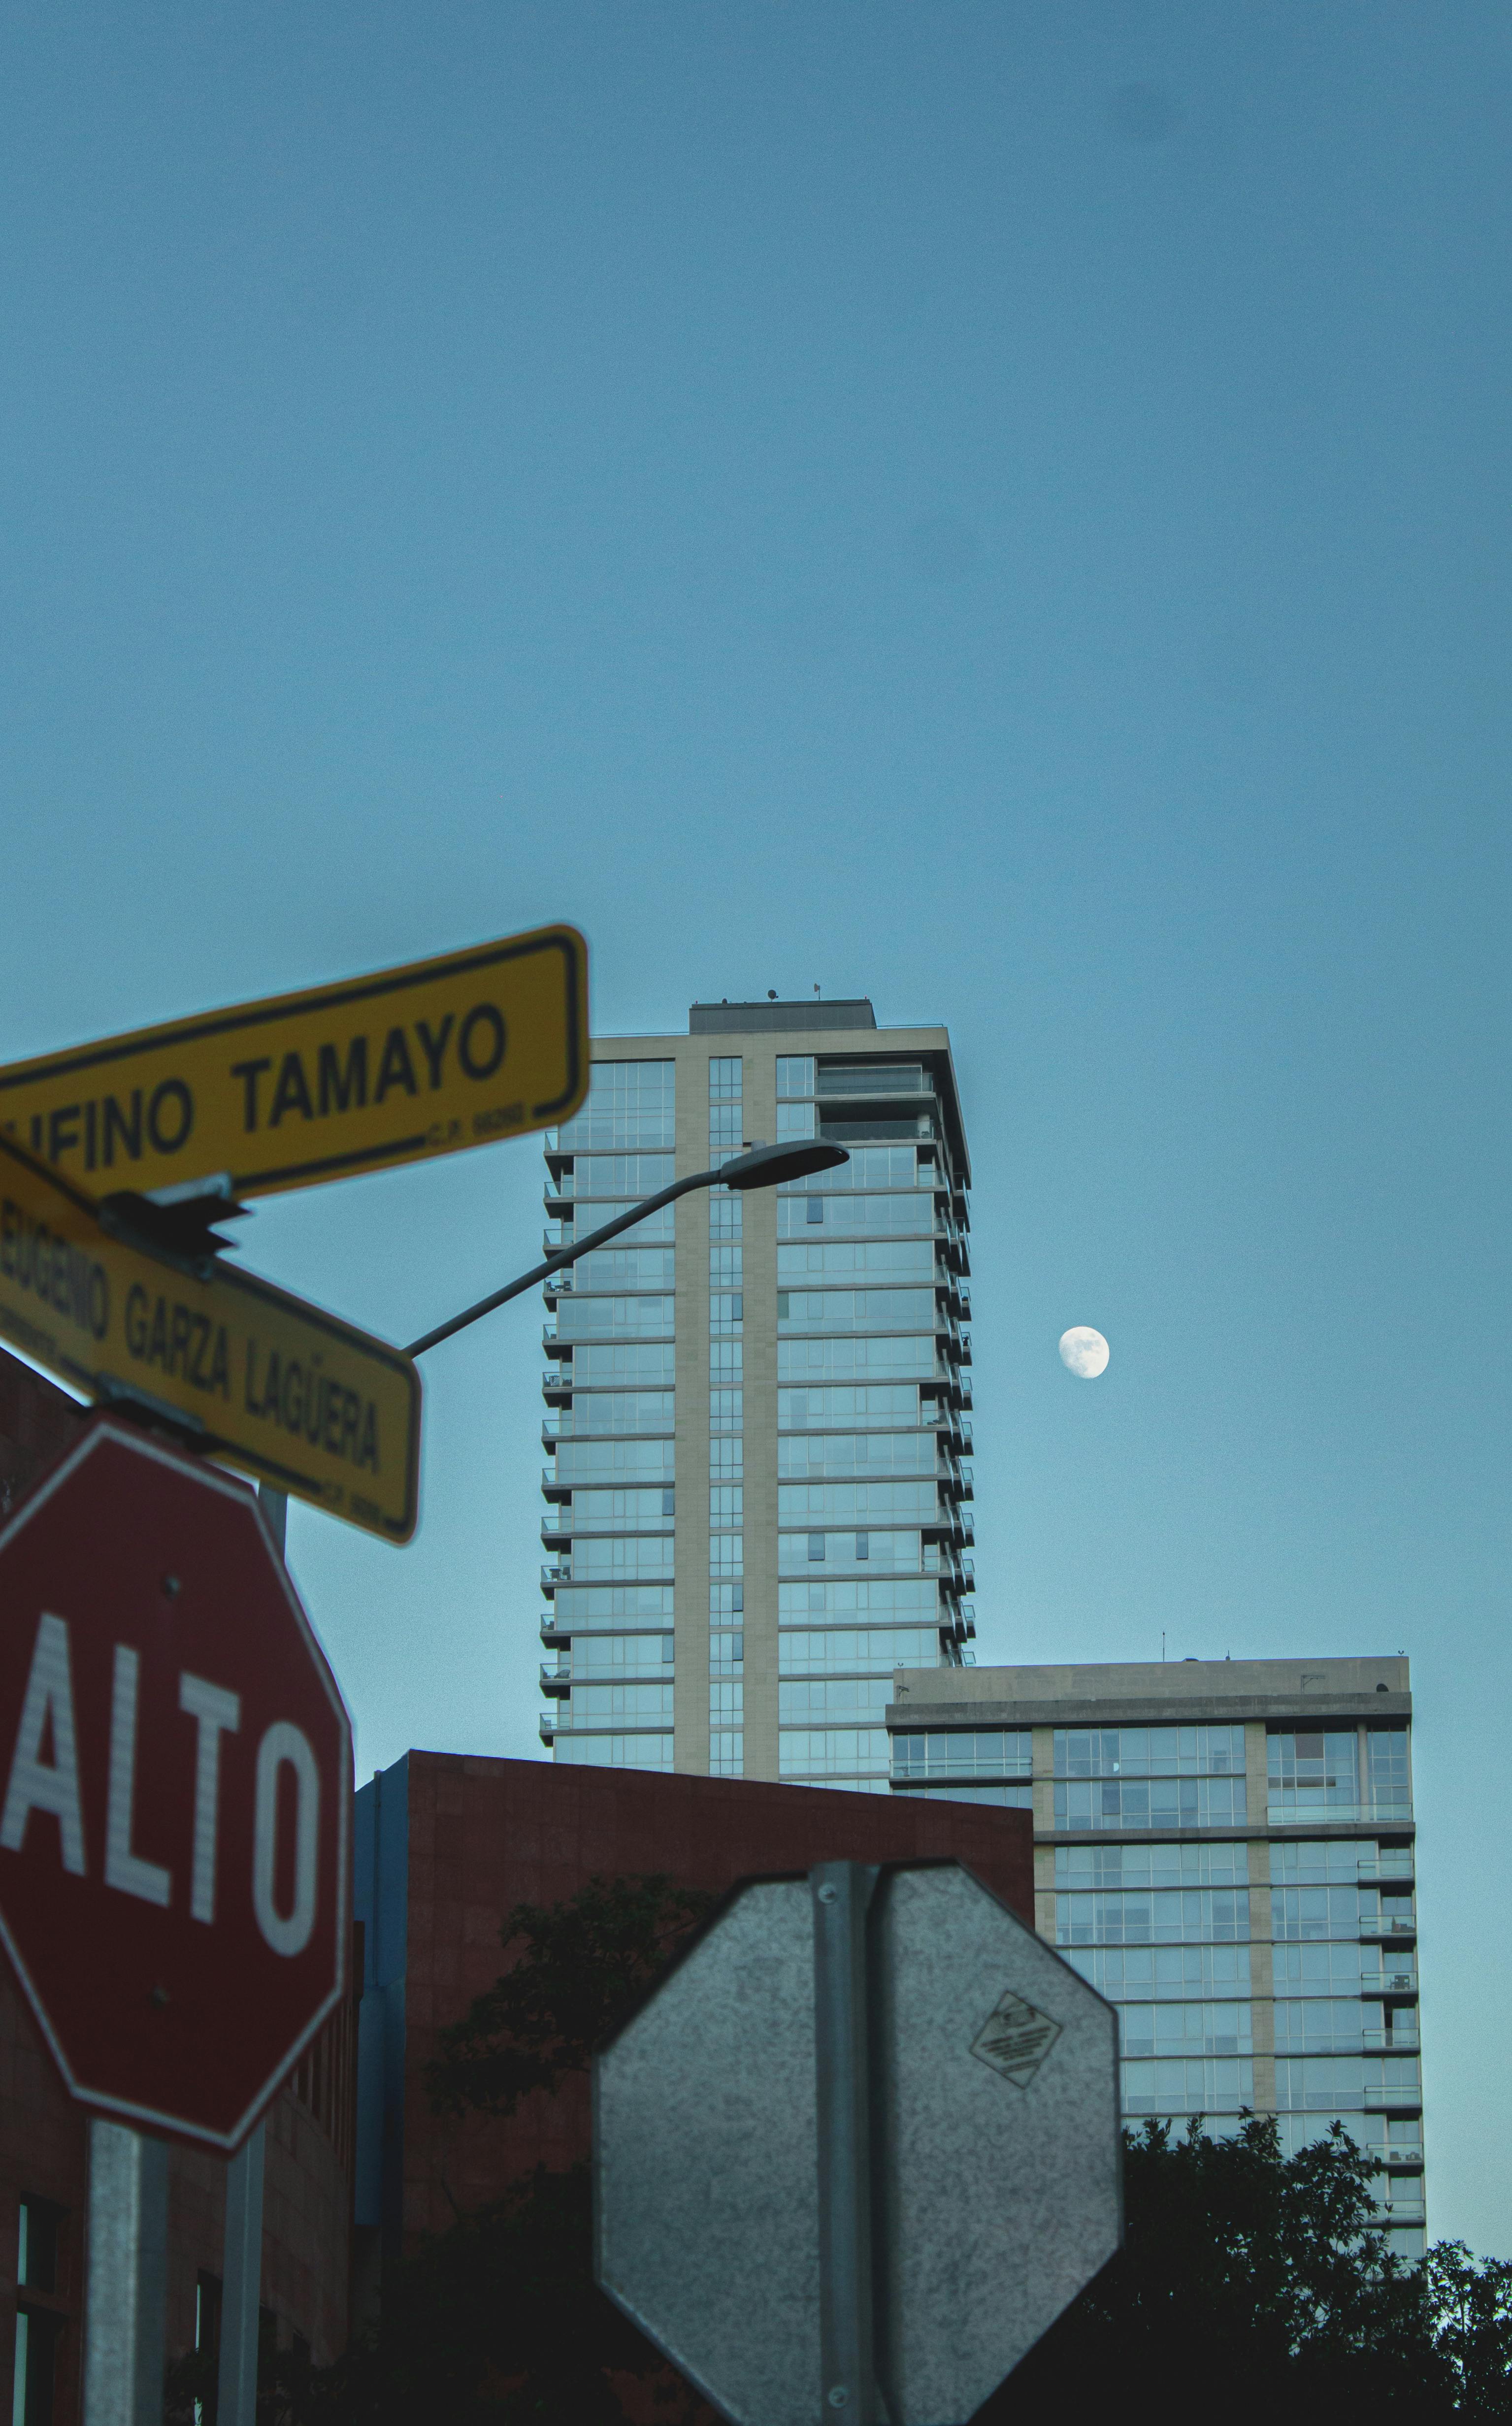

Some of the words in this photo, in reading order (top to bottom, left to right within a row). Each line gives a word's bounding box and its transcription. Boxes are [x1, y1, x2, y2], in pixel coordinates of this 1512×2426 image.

[230, 1003, 507, 1132] TAMAYO
[125, 1283, 230, 1403] GARZA
[0, 1611, 320, 1958] ALTO
